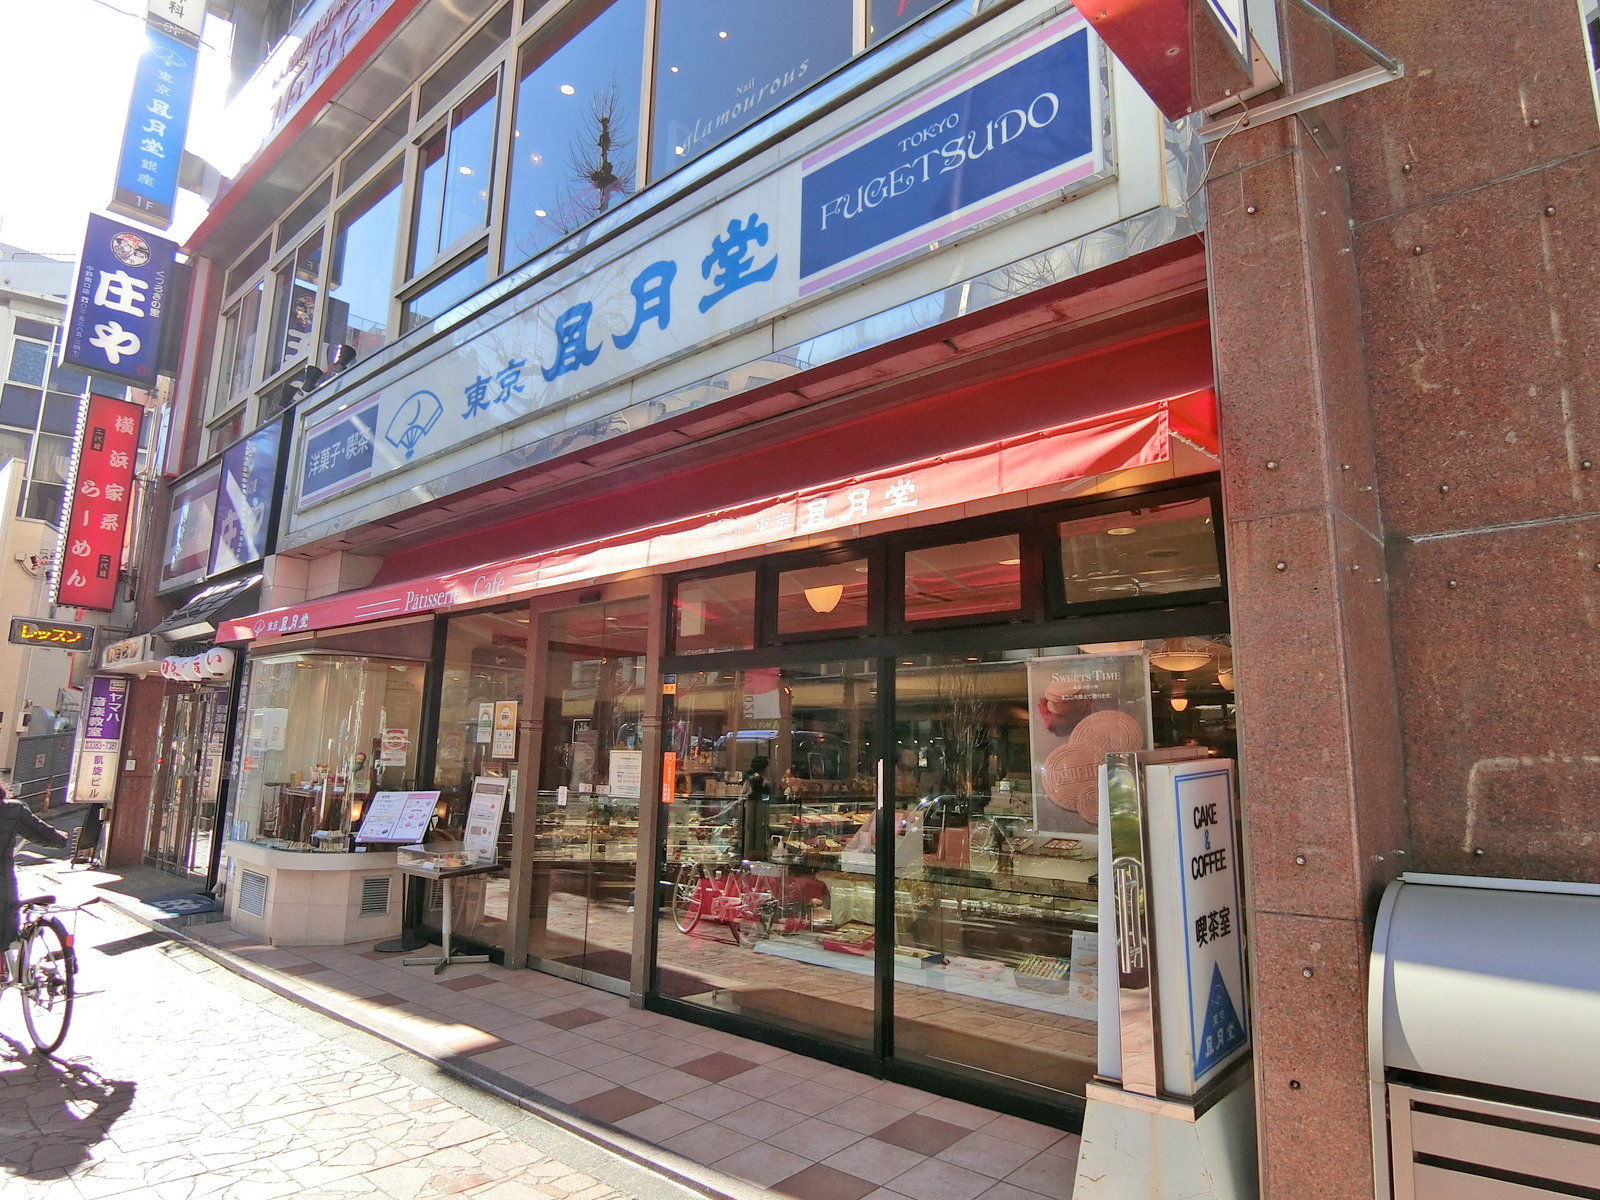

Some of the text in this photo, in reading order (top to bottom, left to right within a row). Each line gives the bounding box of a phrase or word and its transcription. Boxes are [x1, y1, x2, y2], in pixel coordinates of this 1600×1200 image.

[168, 0, 187, 18] 科
[736, 77, 755, 97] Nail
[681, 58, 809, 157] glamourous
[898, 112, 960, 153] TOKYO
[820, 92, 1060, 231] FUGETSUDO
[136, 196, 154, 211] 1F
[89, 269, 149, 365] 庄や
[100, 415, 135, 531] 横浜家系
[66, 479, 101, 588] らーめん
[473, 572, 505, 600] Café
[21, 624, 82, 643] レッスン
[1052, 670, 1121, 684] SWEETS TIME
[87, 696, 107, 737] 音楽教室
[106, 692, 124, 722] ヤマハ
[89, 755, 104, 798] 凱旋ビル
[1193, 803, 1218, 829] CAKE
[1204, 829, 1211, 850] &
[1191, 848, 1227, 880] COFFEE
[1195, 906, 1232, 948] 喫茶室
